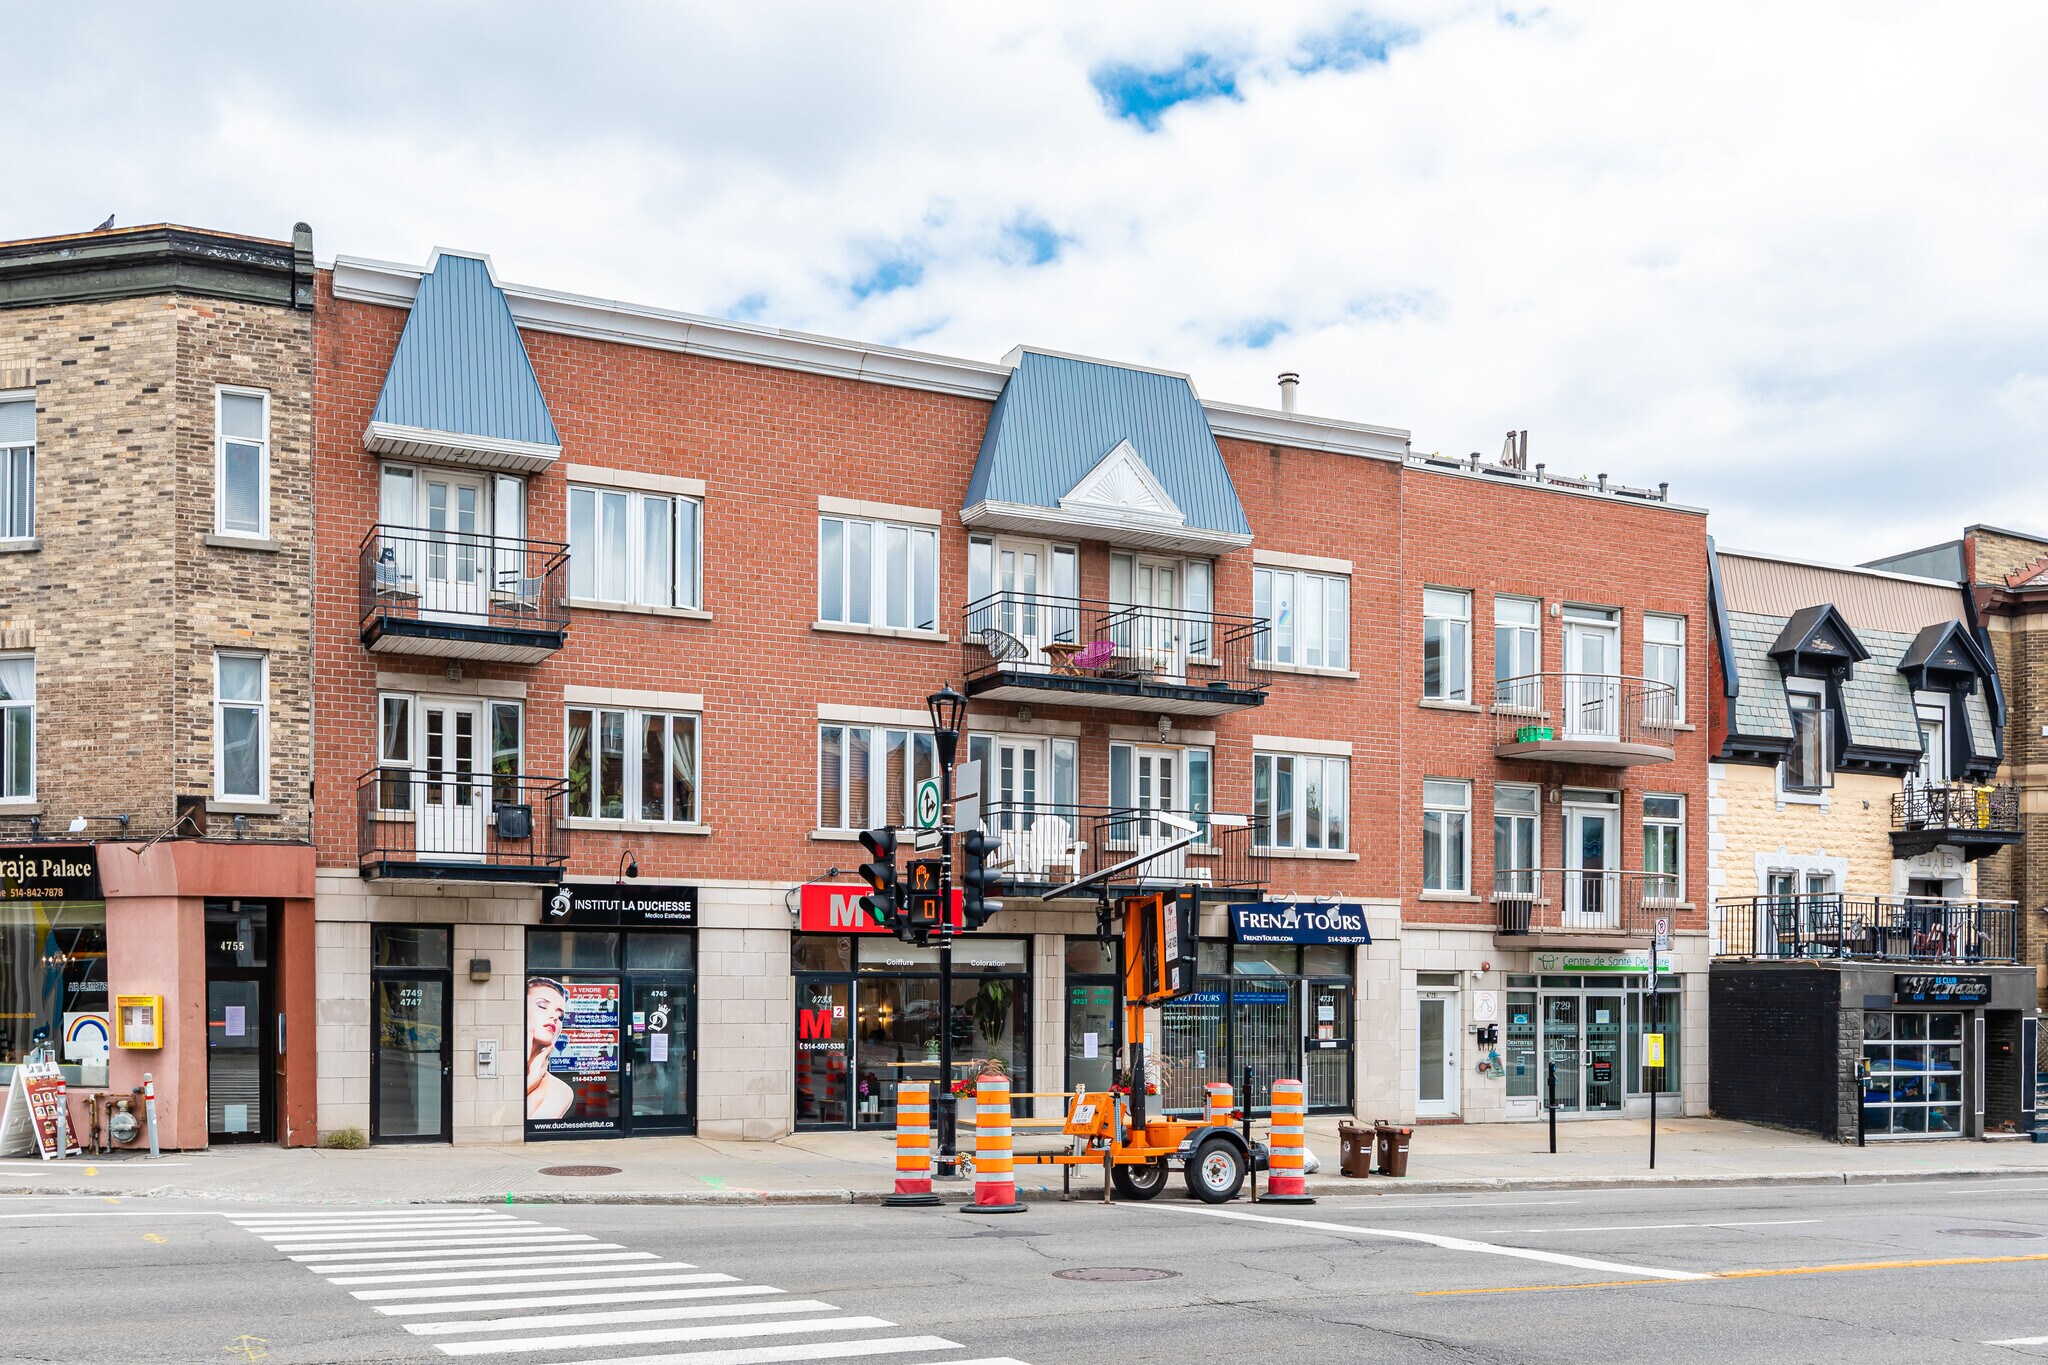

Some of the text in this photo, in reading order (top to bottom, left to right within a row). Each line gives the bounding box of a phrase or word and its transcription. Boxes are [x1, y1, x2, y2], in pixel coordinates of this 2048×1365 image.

[42, 859, 92, 877] Palace
[10, 888, 64, 897] 514-842-7878
[574, 900, 691, 912] INSTITUT LA DUCHESSE
[1239, 911, 1362, 930] FRENZY TOURS
[220, 941, 245, 951] 4755
[886, 958, 914, 967] Coiffure
[970, 959, 1006, 967] Coloration
[1562, 955, 1591, 966] Centre
[1594, 955, 1605, 966] de
[1608, 956, 1632, 966] Santé
[400, 989, 423, 997] 4749
[1072, 988, 1087, 996] 4741
[400, 998, 422, 1006] 4747
[1194, 993, 1220, 1002] TOURS
[1551, 1001, 1571, 1010] 4729
[800, 1008, 832, 1040] M
[534, 1121, 614, 1129] www.duchesseinstitut.ca
